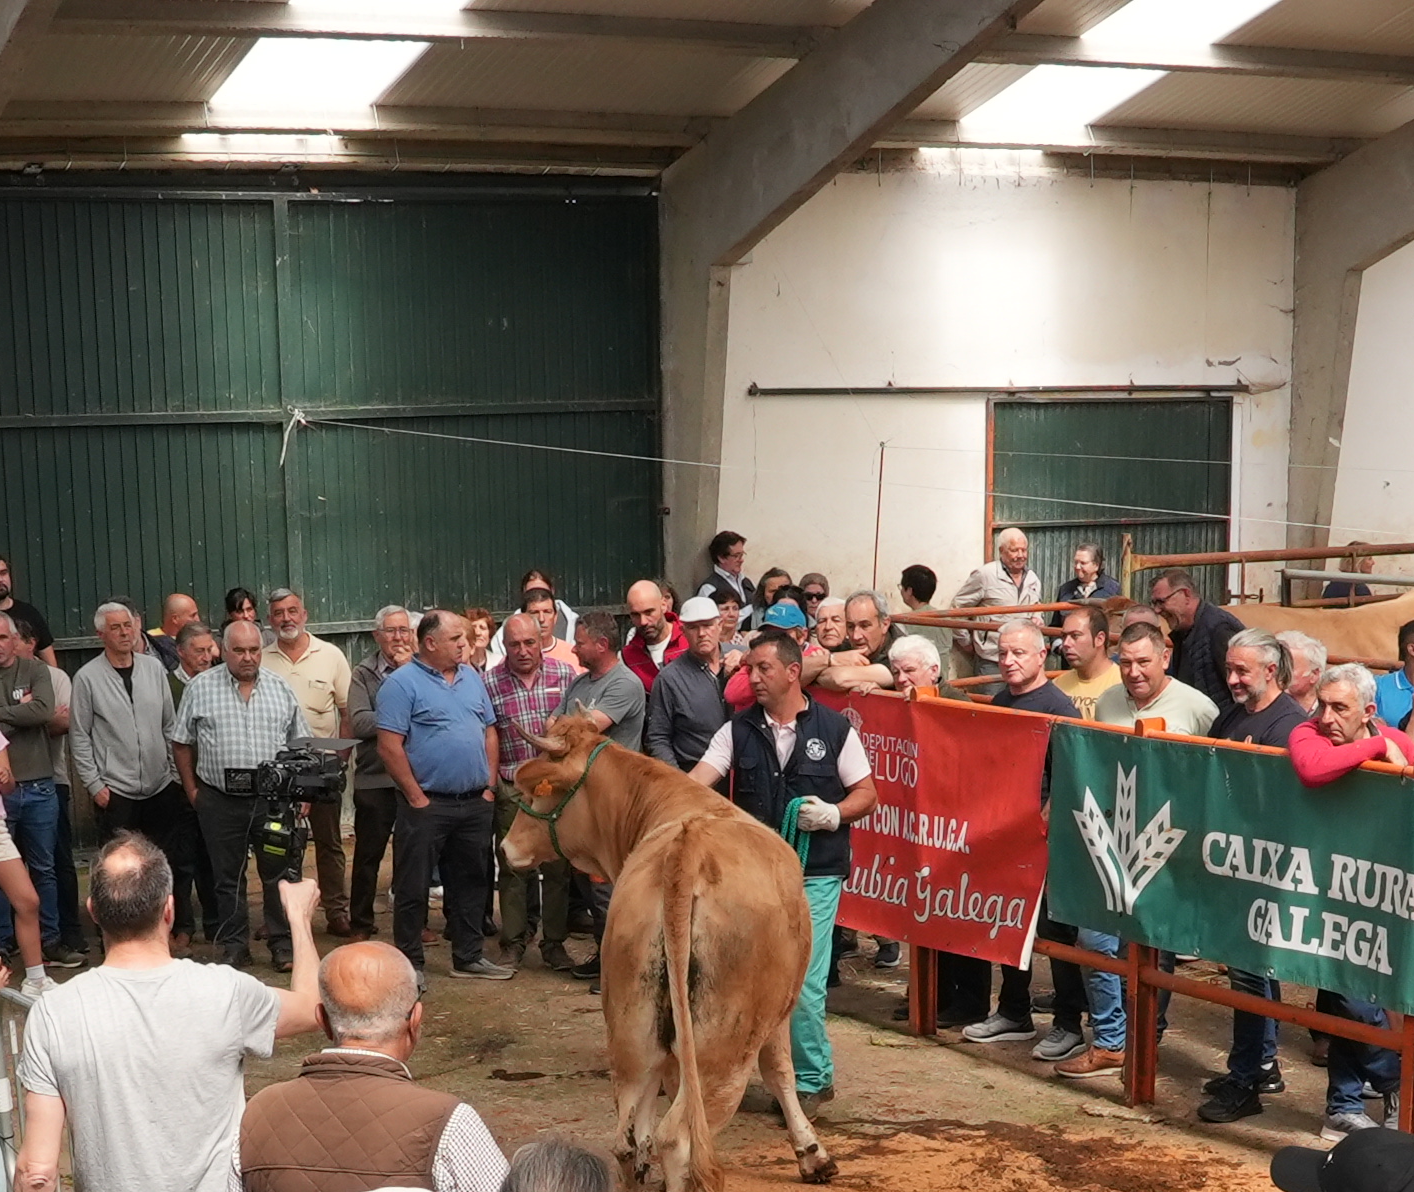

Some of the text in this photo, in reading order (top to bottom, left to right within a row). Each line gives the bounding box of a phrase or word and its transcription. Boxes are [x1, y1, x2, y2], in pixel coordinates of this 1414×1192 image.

[874, 751, 919, 788] LUGO
[873, 803, 900, 837] CON
[1201, 831, 1320, 896] CAIXA
[913, 865, 1027, 940] Galega
[1247, 898, 1393, 976] GALEGA
